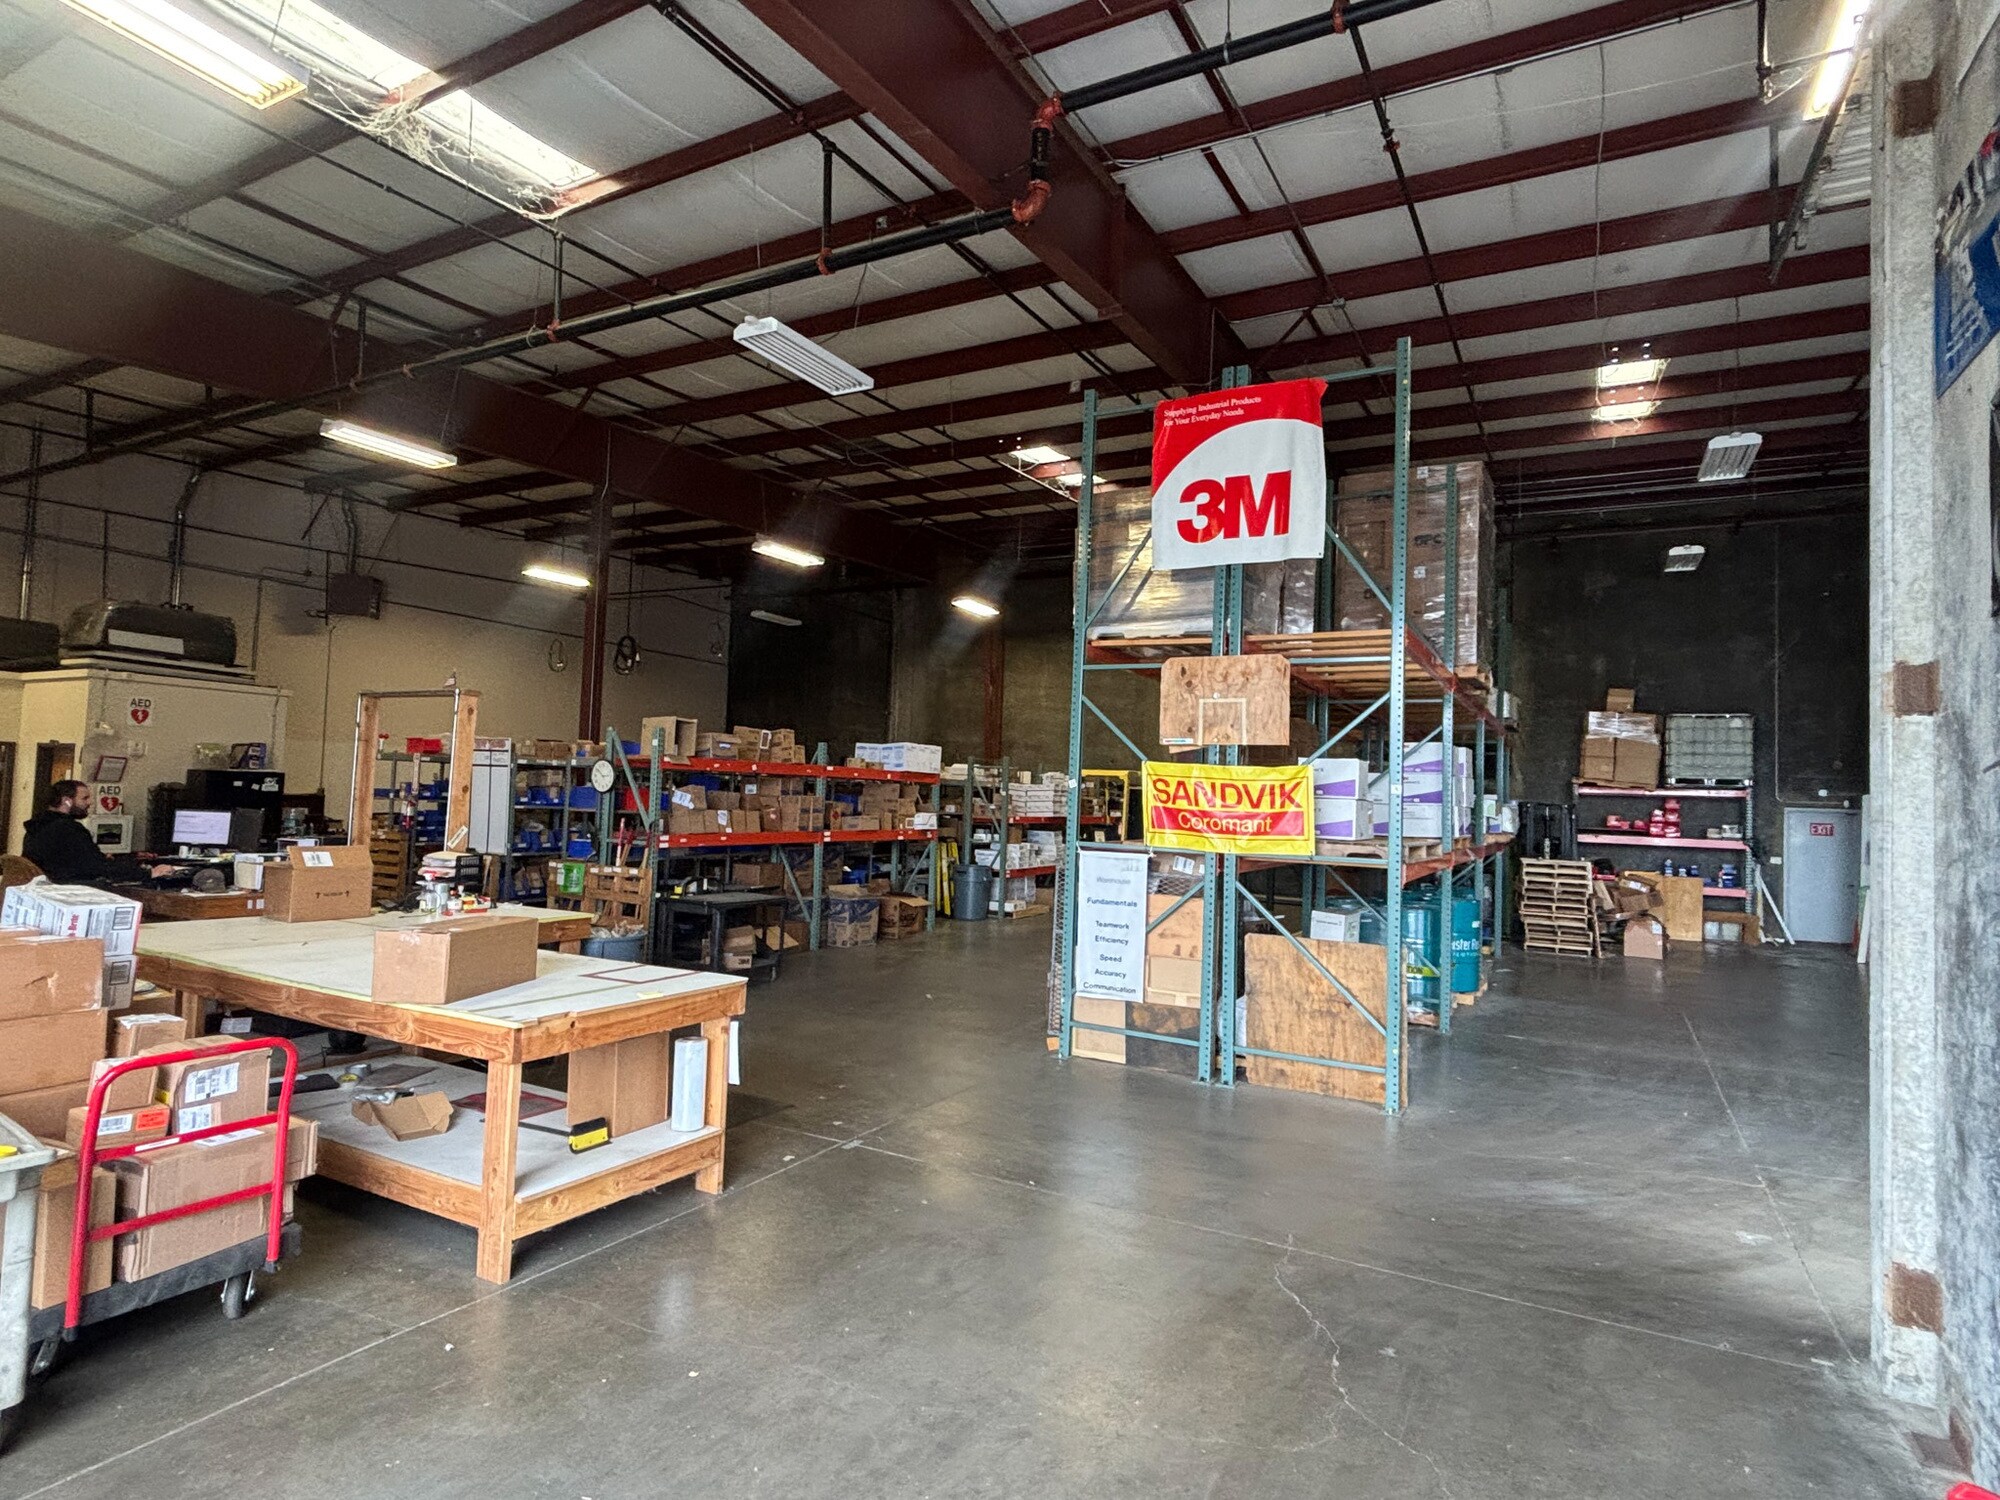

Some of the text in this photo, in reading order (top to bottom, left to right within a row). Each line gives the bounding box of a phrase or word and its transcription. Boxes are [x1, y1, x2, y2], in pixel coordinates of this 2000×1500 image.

[1163, 396, 1262, 418] Supplying Industrial Products
[1174, 417, 1190, 426] Your
[1190, 412, 1222, 423] Everyday
[1222, 407, 1245, 417] Needs
[1176, 469, 1292, 544] 3M
[130, 698, 152, 708] AED
[99, 785, 121, 795] AED
[1152, 777, 1304, 810] SANDVIK
[1178, 811, 1273, 833] Coromant
[1811, 824, 1833, 835] EXIT
[1086, 896, 1138, 908] Fundamentals
[1095, 920, 1130, 930] Teamwork
[1095, 935, 1129, 946] Efficiency
[1099, 953, 1123, 964] Speed
[1094, 968, 1127, 979] Accuracy
[1083, 981, 1137, 994] Communication
